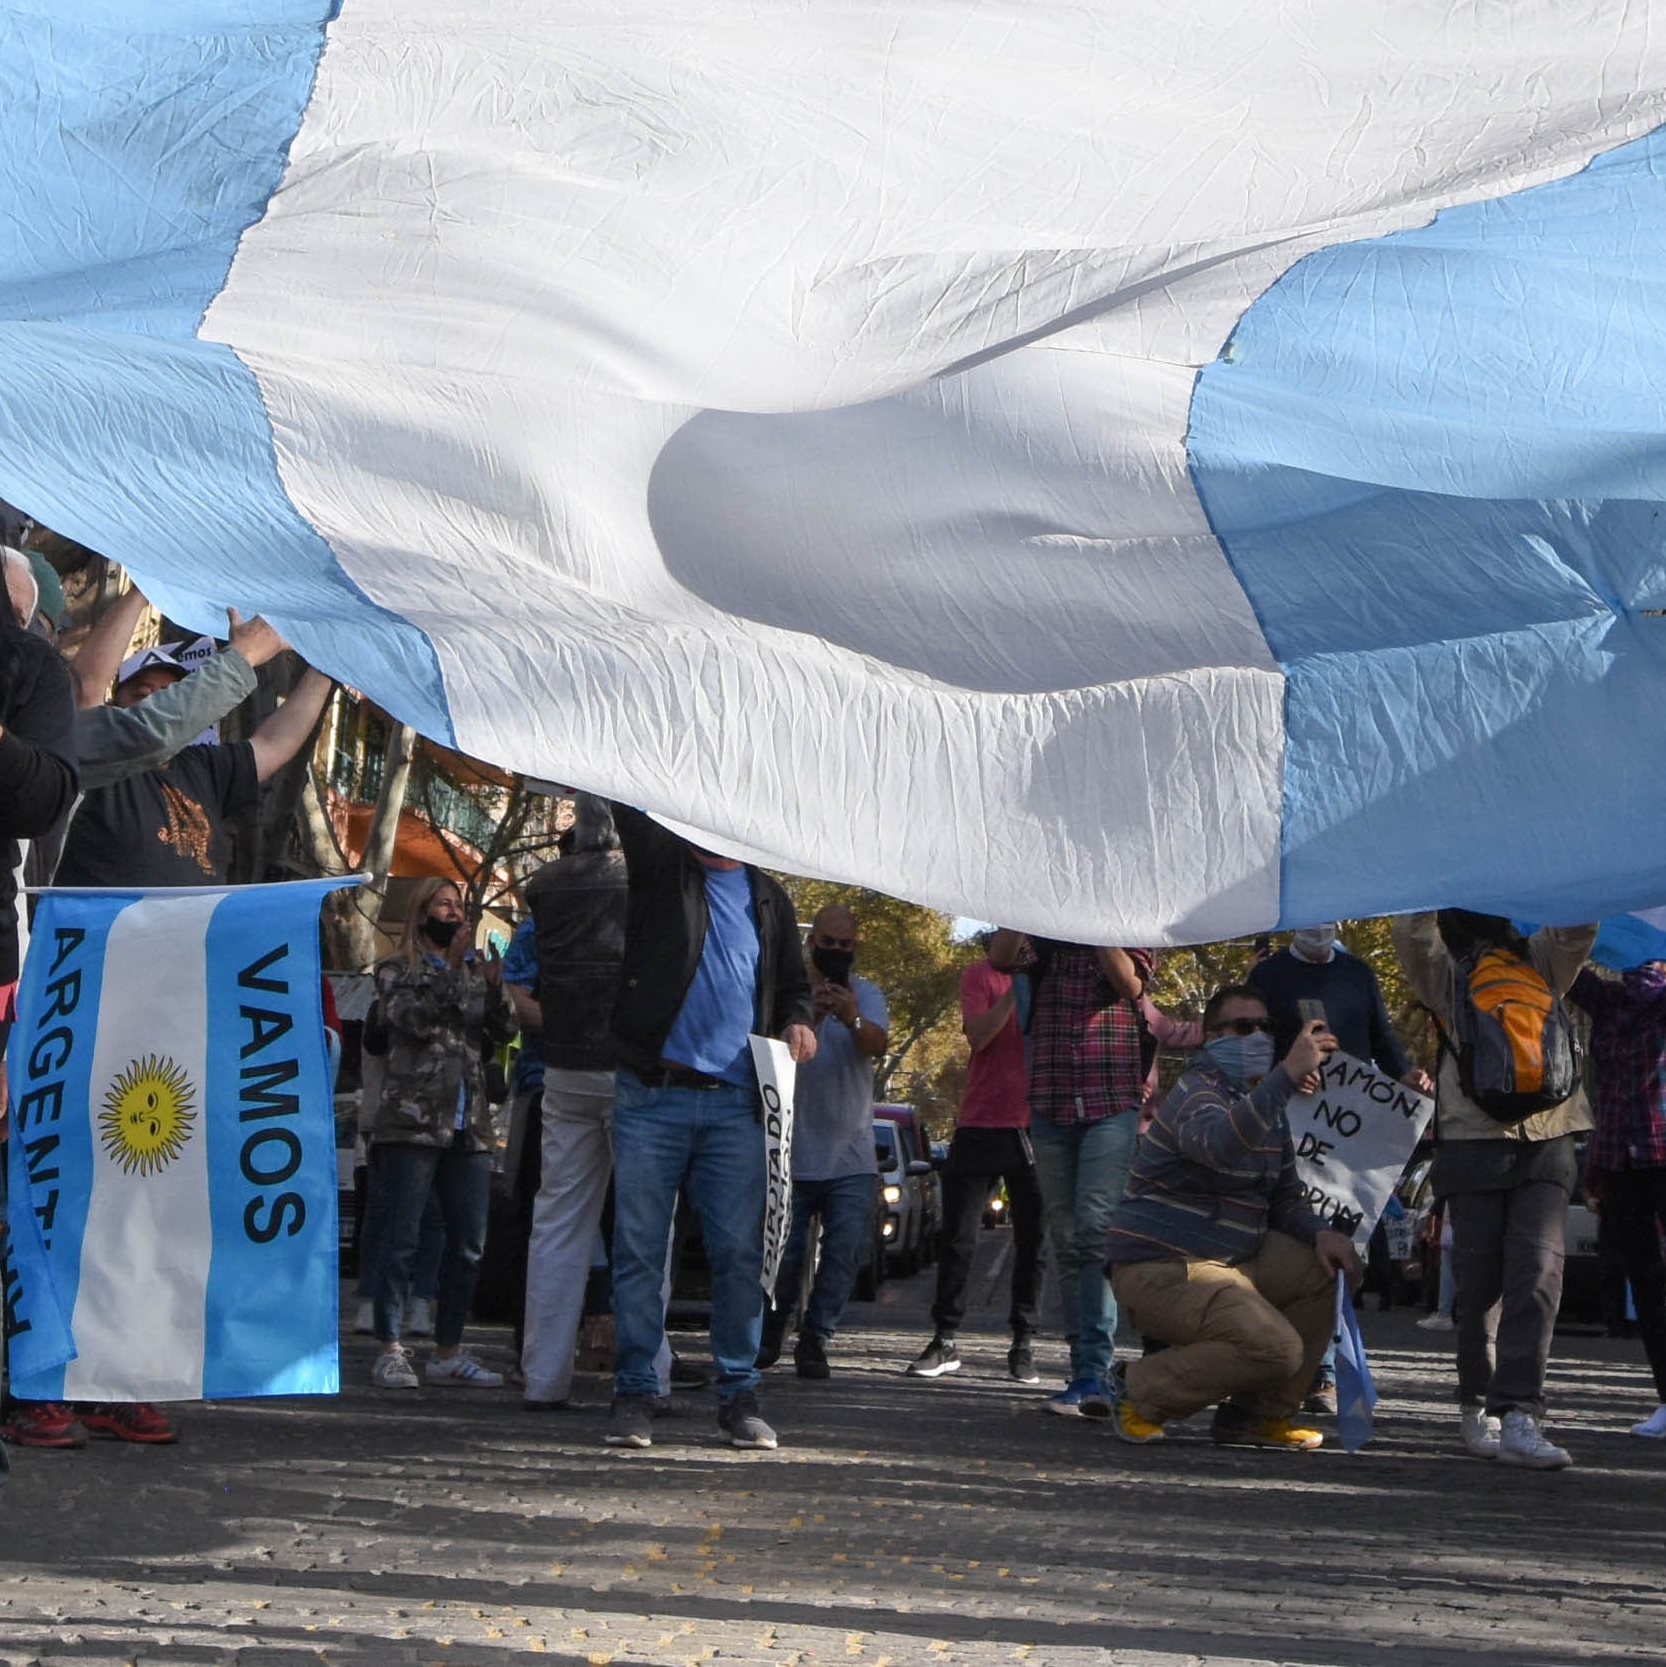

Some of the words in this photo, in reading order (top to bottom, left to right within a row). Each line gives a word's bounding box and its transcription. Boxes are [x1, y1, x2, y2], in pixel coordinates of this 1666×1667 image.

[177, 645, 212, 663] emos
[19, 927, 86, 1250] ARGENT
[237, 942, 306, 1244] VAMOS
[1313, 1099, 1361, 1137] NO
[1297, 1133, 1335, 1166] DE
